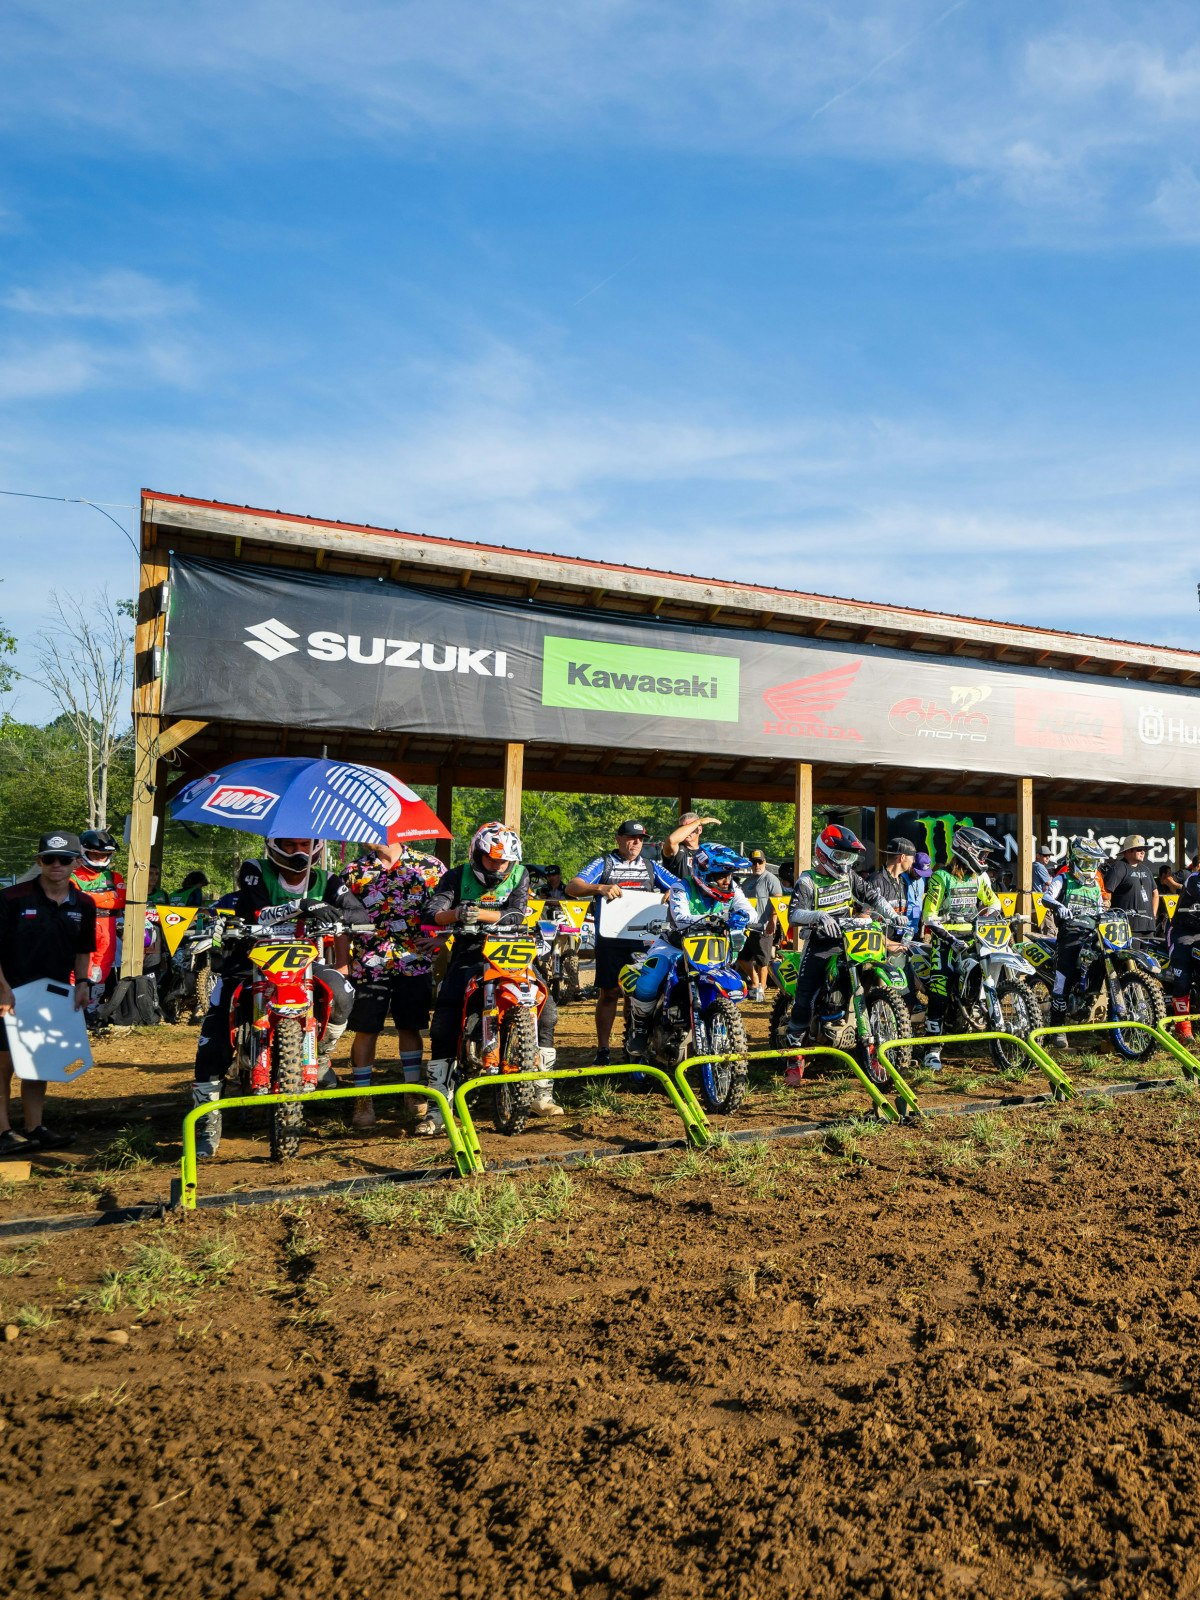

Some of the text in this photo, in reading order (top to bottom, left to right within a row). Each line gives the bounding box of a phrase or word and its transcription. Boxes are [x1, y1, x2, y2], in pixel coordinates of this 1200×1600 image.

[307, 631, 507, 677] SUZUKI
[567, 661, 718, 700] Kawasaki
[763, 721, 864, 742] HONDA
[213, 790, 271, 814] 100%
[851, 932, 880, 954] 20
[983, 928, 1007, 945] 47
[1105, 923, 1127, 942] 88
[262, 946, 312, 970] 76
[488, 945, 535, 964] 45
[690, 939, 725, 962] 70
